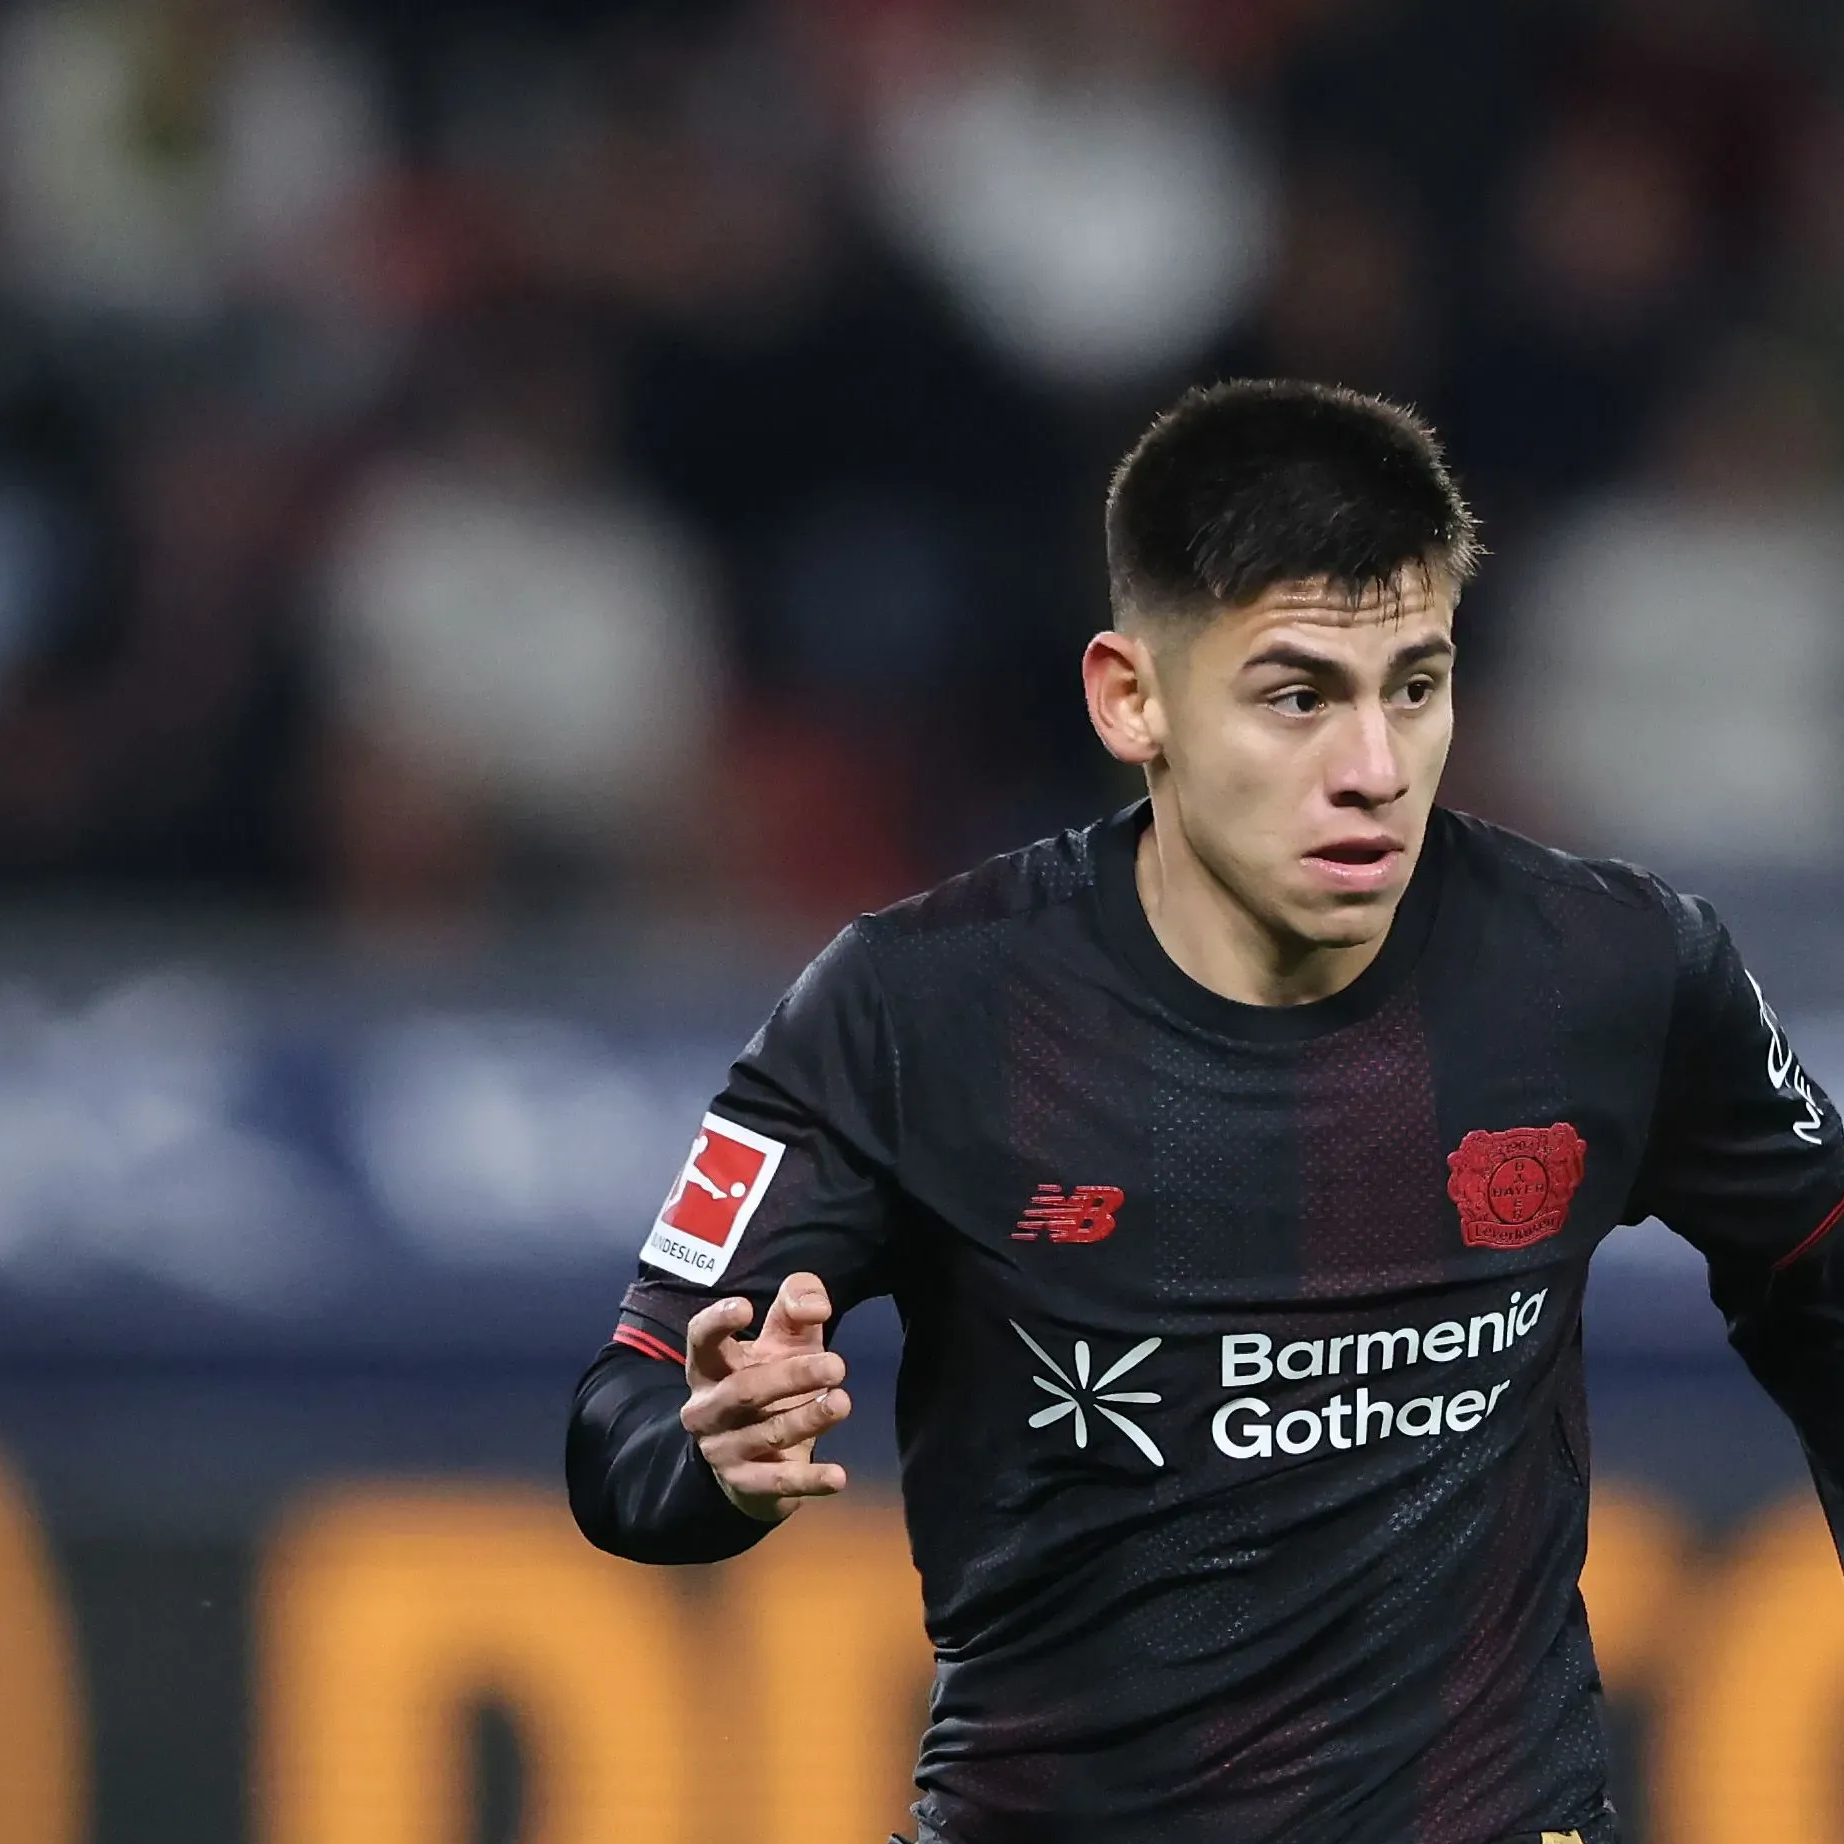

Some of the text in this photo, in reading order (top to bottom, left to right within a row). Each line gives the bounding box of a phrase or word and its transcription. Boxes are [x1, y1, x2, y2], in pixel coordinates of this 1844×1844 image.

[1492, 1183, 1545, 1198] BAYER
[1221, 1287, 1549, 1387] Barmenia
[1211, 1379, 1511, 1460] Gothaer
